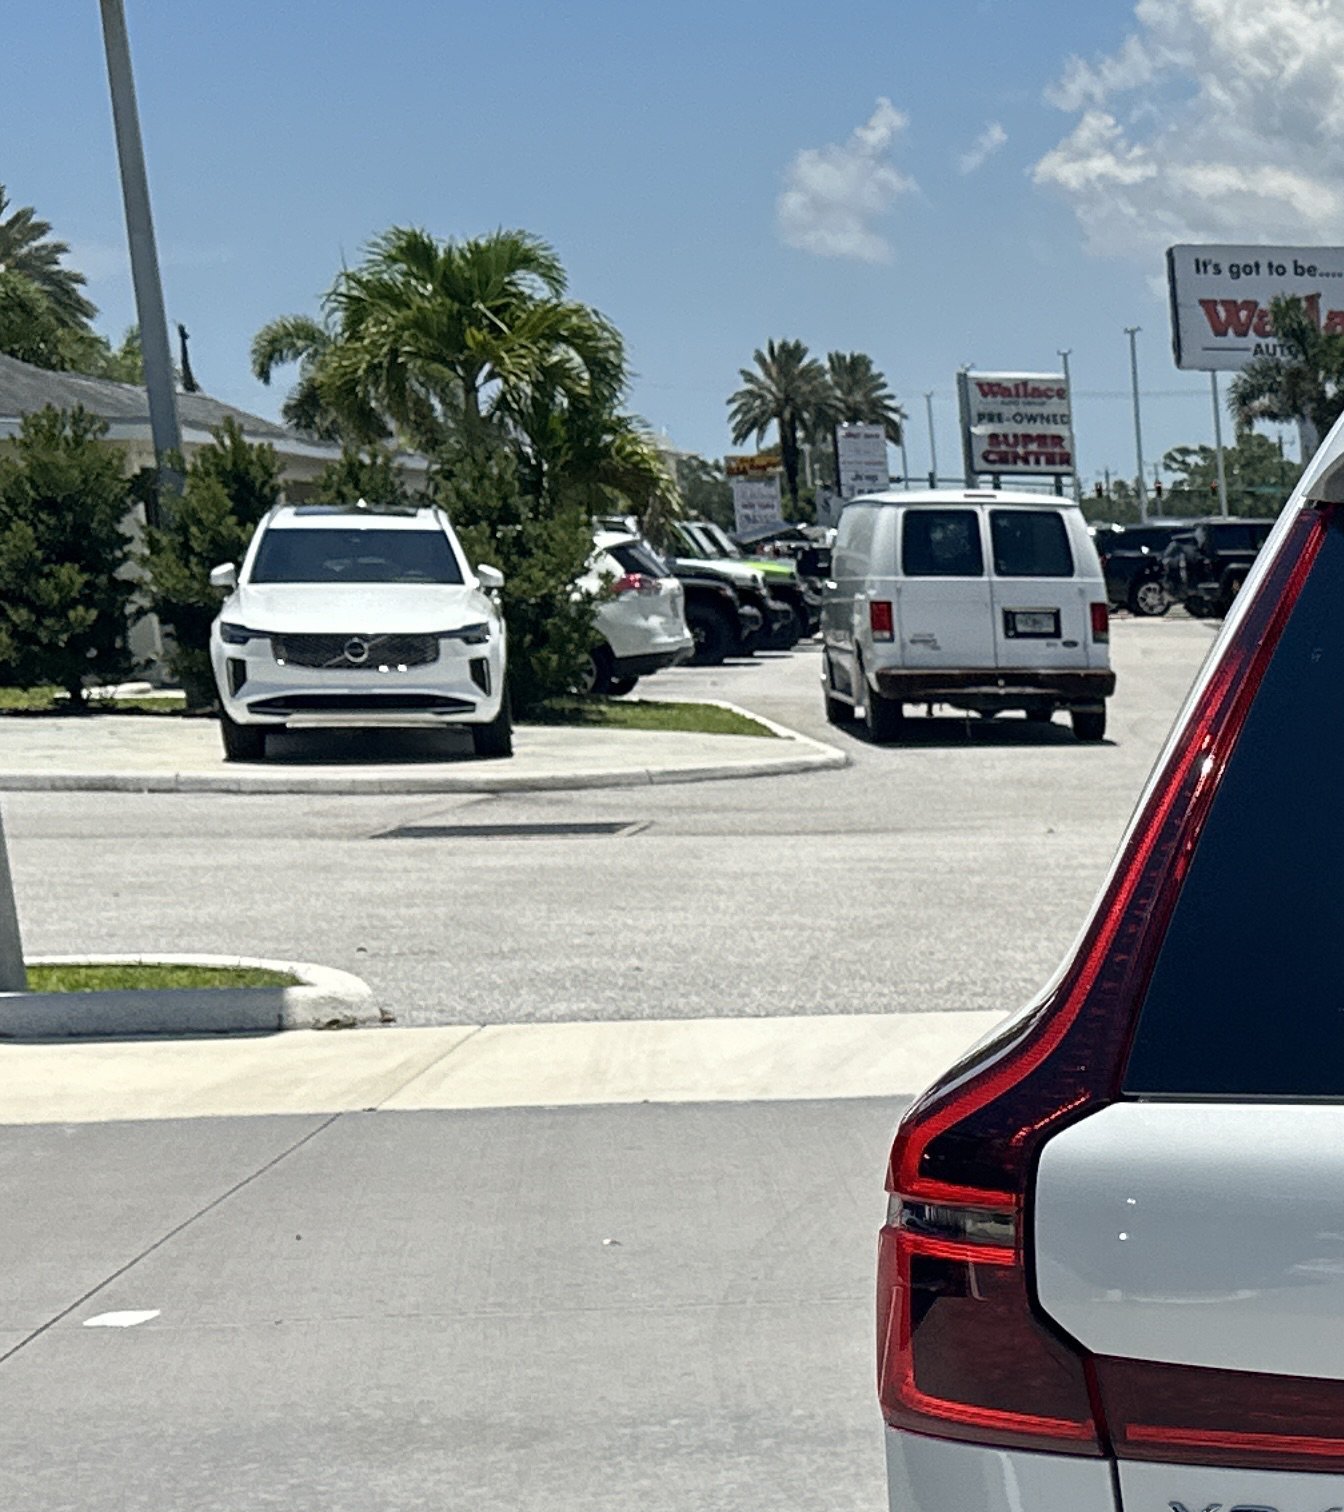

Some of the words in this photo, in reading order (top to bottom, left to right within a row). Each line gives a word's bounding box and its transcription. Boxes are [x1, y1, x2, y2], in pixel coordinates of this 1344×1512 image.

[1194, 257, 1222, 276] It's
[1228, 260, 1260, 280] got
[1267, 260, 1287, 277] to
[975, 380, 1067, 400] Wallace
[977, 411, 1071, 425] PRE-OWNED
[987, 432, 1065, 450] SUPER
[981, 449, 1072, 466] CENTER
